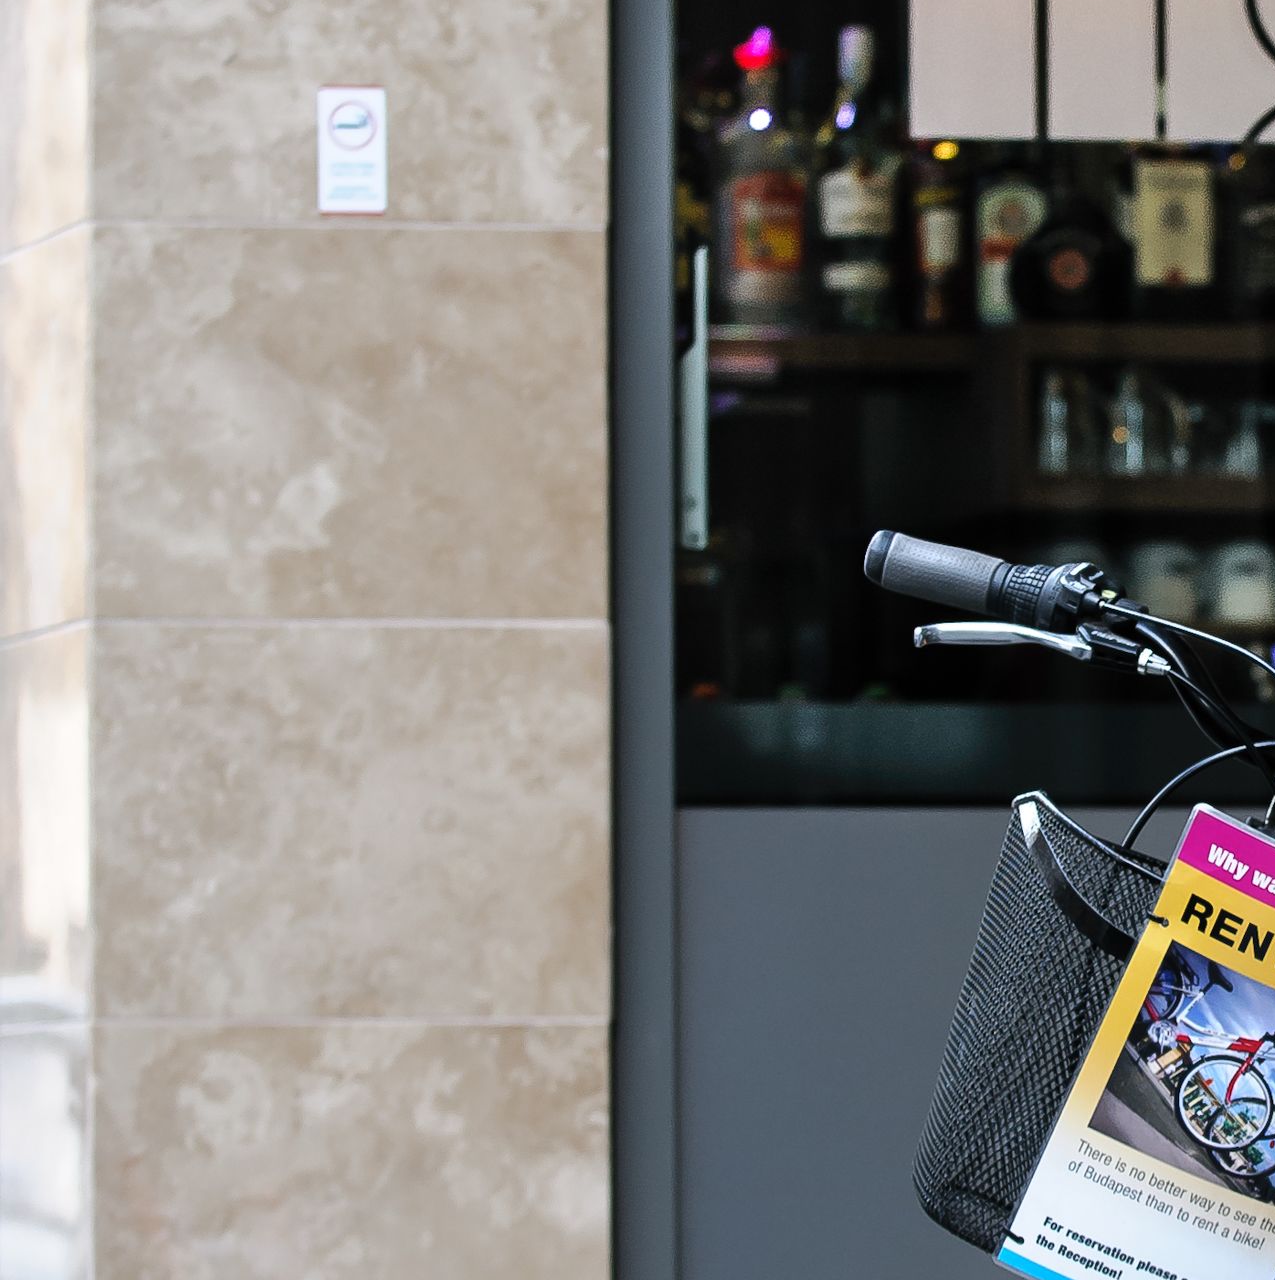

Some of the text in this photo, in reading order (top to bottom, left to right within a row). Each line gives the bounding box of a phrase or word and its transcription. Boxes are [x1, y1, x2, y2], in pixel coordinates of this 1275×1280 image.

[1207, 843, 1249, 880] Why
[1067, 1160, 1266, 1251] of Budapest than to rent a bike!
[1079, 1139, 1112, 1166] There
[1115, 1158, 1127, 1172] is
[1129, 1166, 1146, 1182] no
[1148, 1171, 1187, 1198] better
[1190, 1192, 1215, 1213] way
[1217, 1201, 1231, 1217] to
[1233, 1208, 1256, 1226] see
[1036, 1233, 1123, 1280] the Reception!
[1043, 1216, 1064, 1235] For
[1065, 1227, 1135, 1265] reservation
